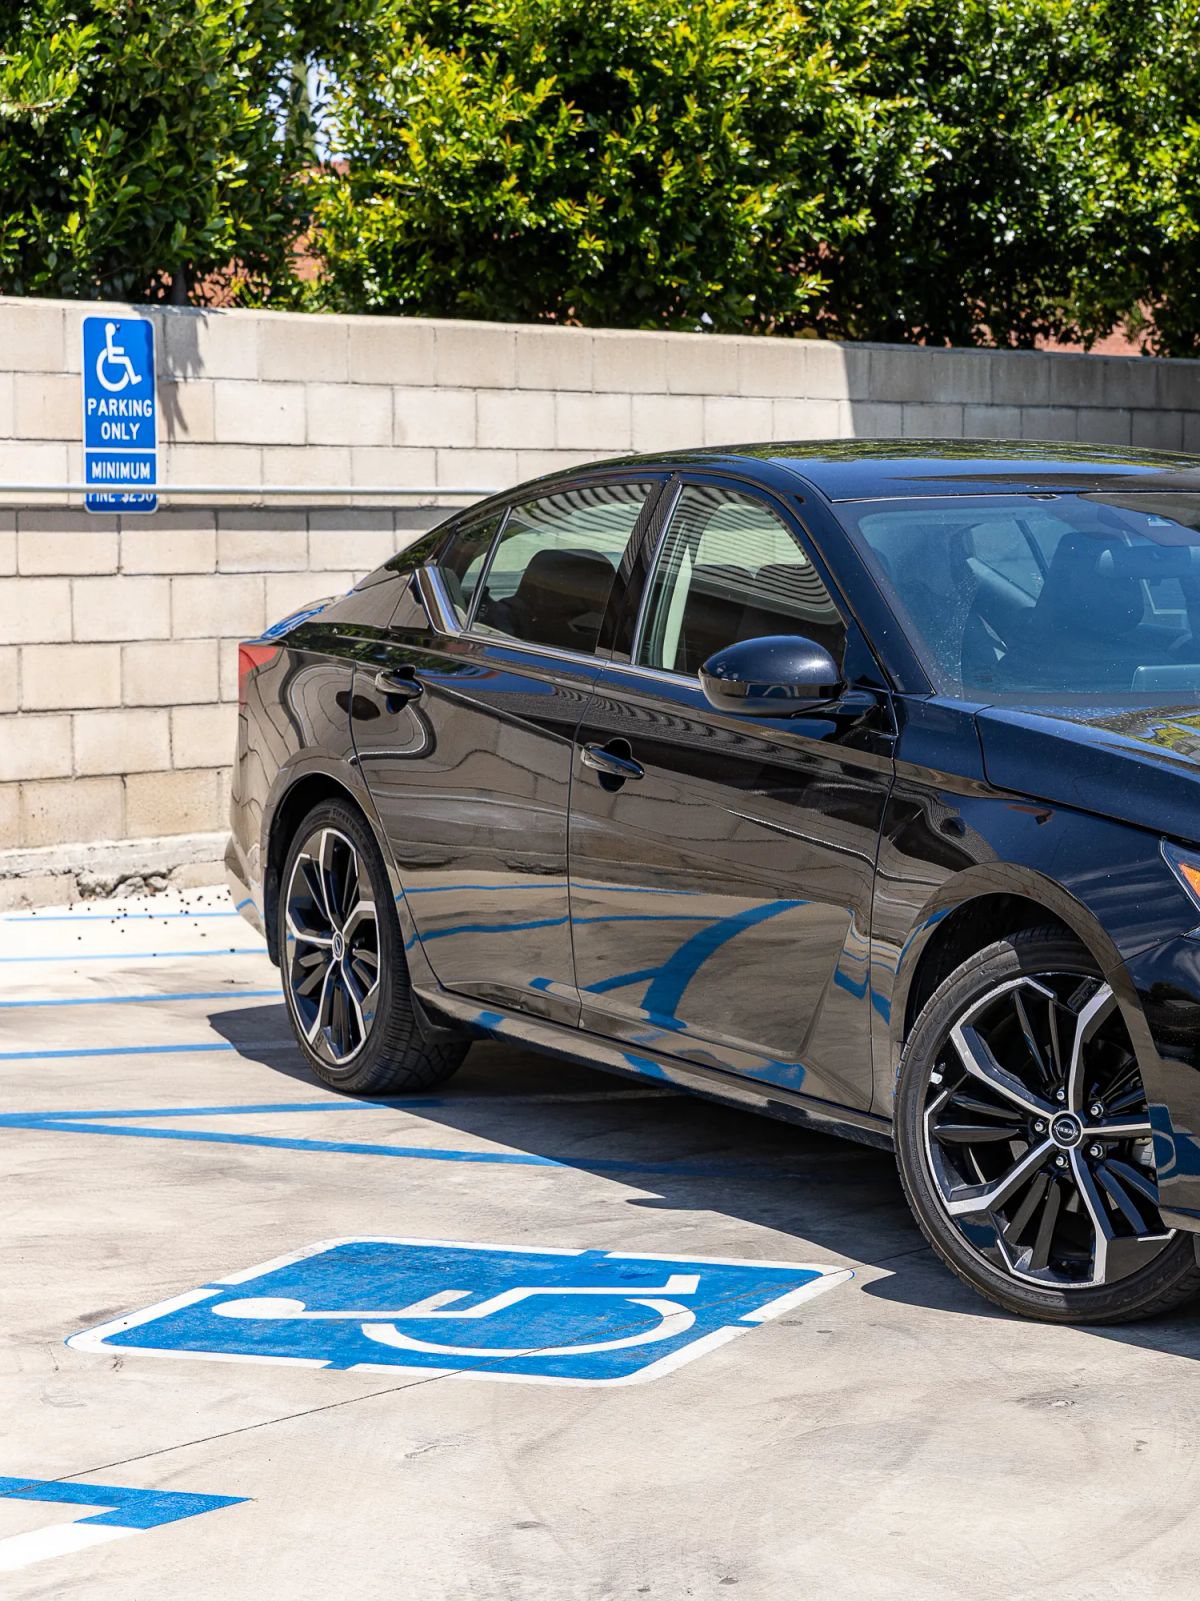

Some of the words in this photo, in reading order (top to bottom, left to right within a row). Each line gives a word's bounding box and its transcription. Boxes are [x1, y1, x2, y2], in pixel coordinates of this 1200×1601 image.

[88, 398, 152, 417] PARKING
[101, 422, 140, 440] ONLY
[92, 461, 150, 479] MINIMUM
